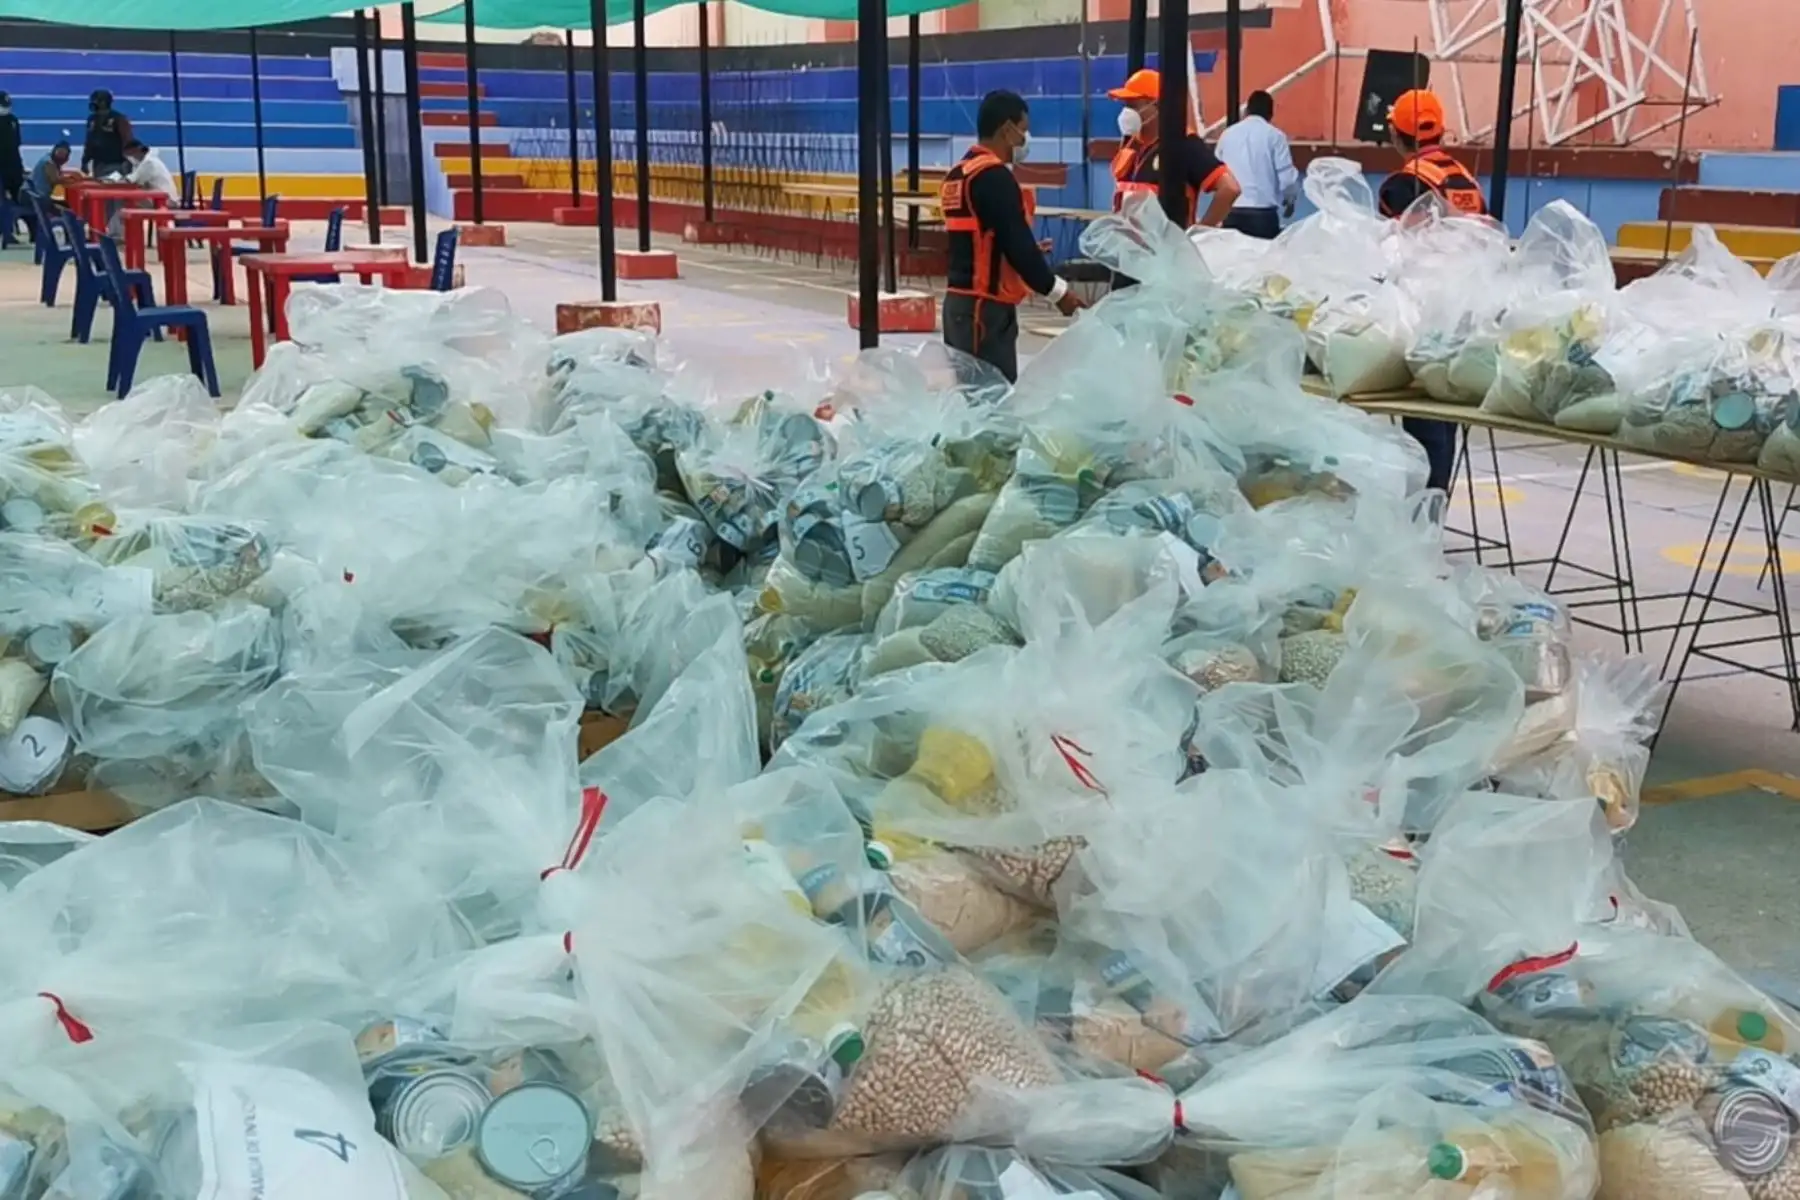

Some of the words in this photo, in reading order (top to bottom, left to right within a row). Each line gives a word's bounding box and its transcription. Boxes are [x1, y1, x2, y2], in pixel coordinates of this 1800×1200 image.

[852, 536, 865, 561] 5
[21, 733, 47, 758] 2
[294, 1128, 358, 1163] 4
